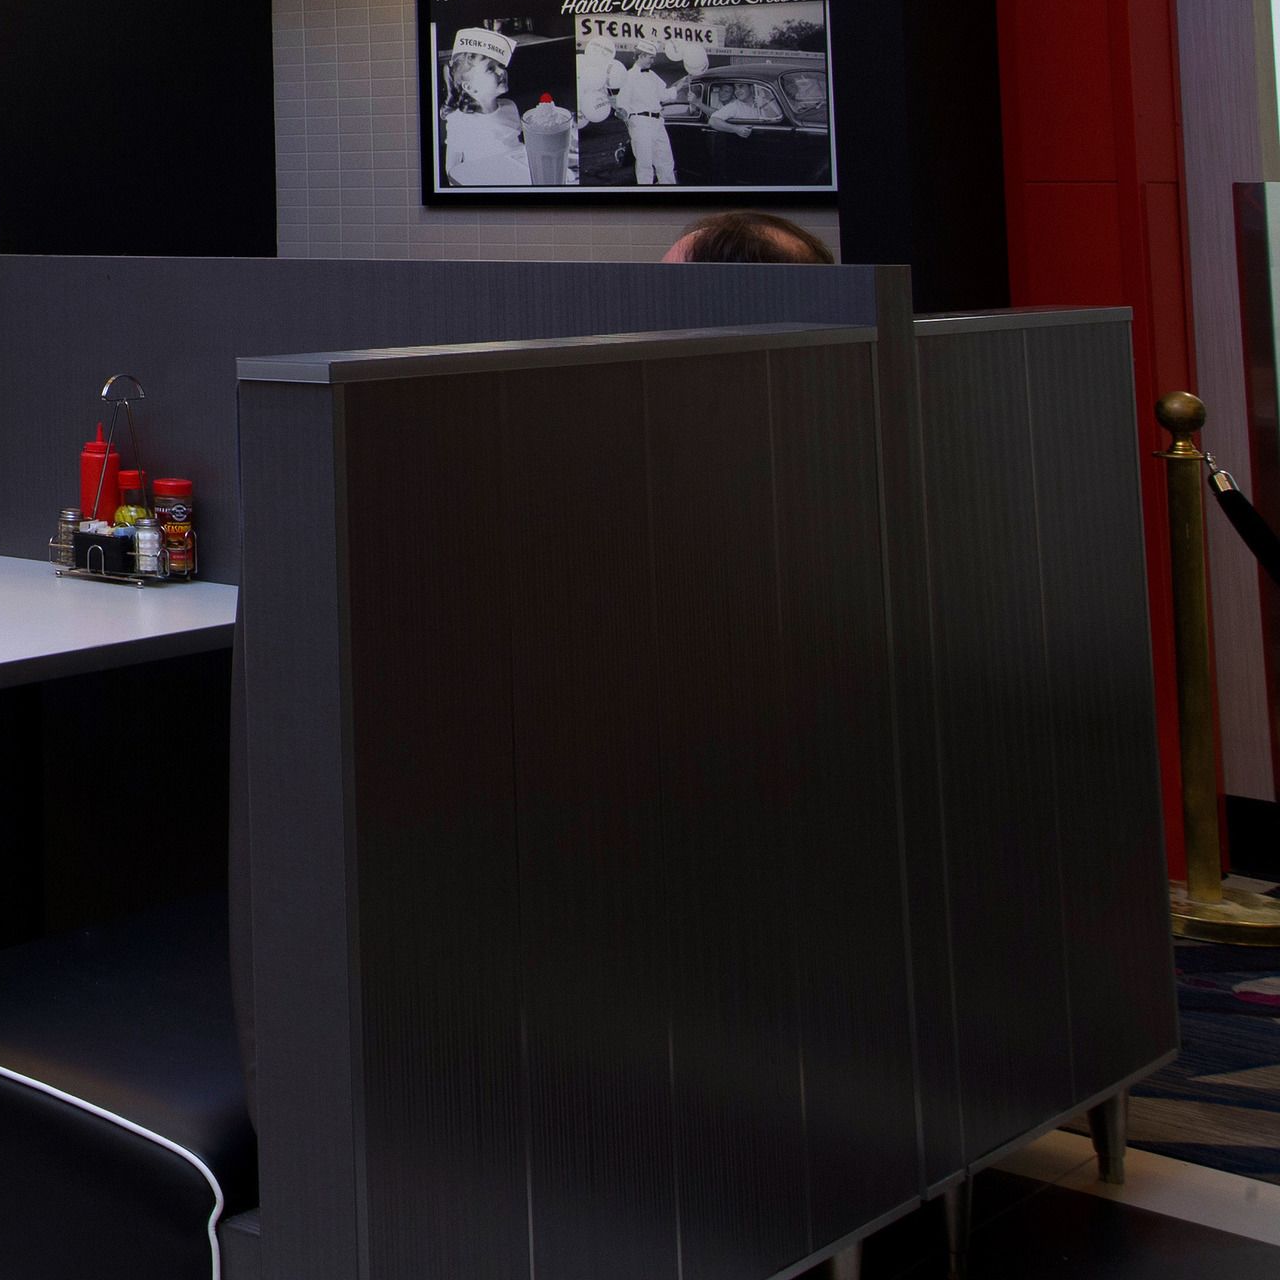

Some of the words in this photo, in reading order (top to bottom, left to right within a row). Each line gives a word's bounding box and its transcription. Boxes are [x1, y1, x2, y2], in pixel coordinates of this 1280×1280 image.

[581, 19, 645, 39] STEAK
[664, 25, 713, 44] SHAKE
[459, 37, 482, 48] STEAK
[487, 43, 505, 56] SHAKE
